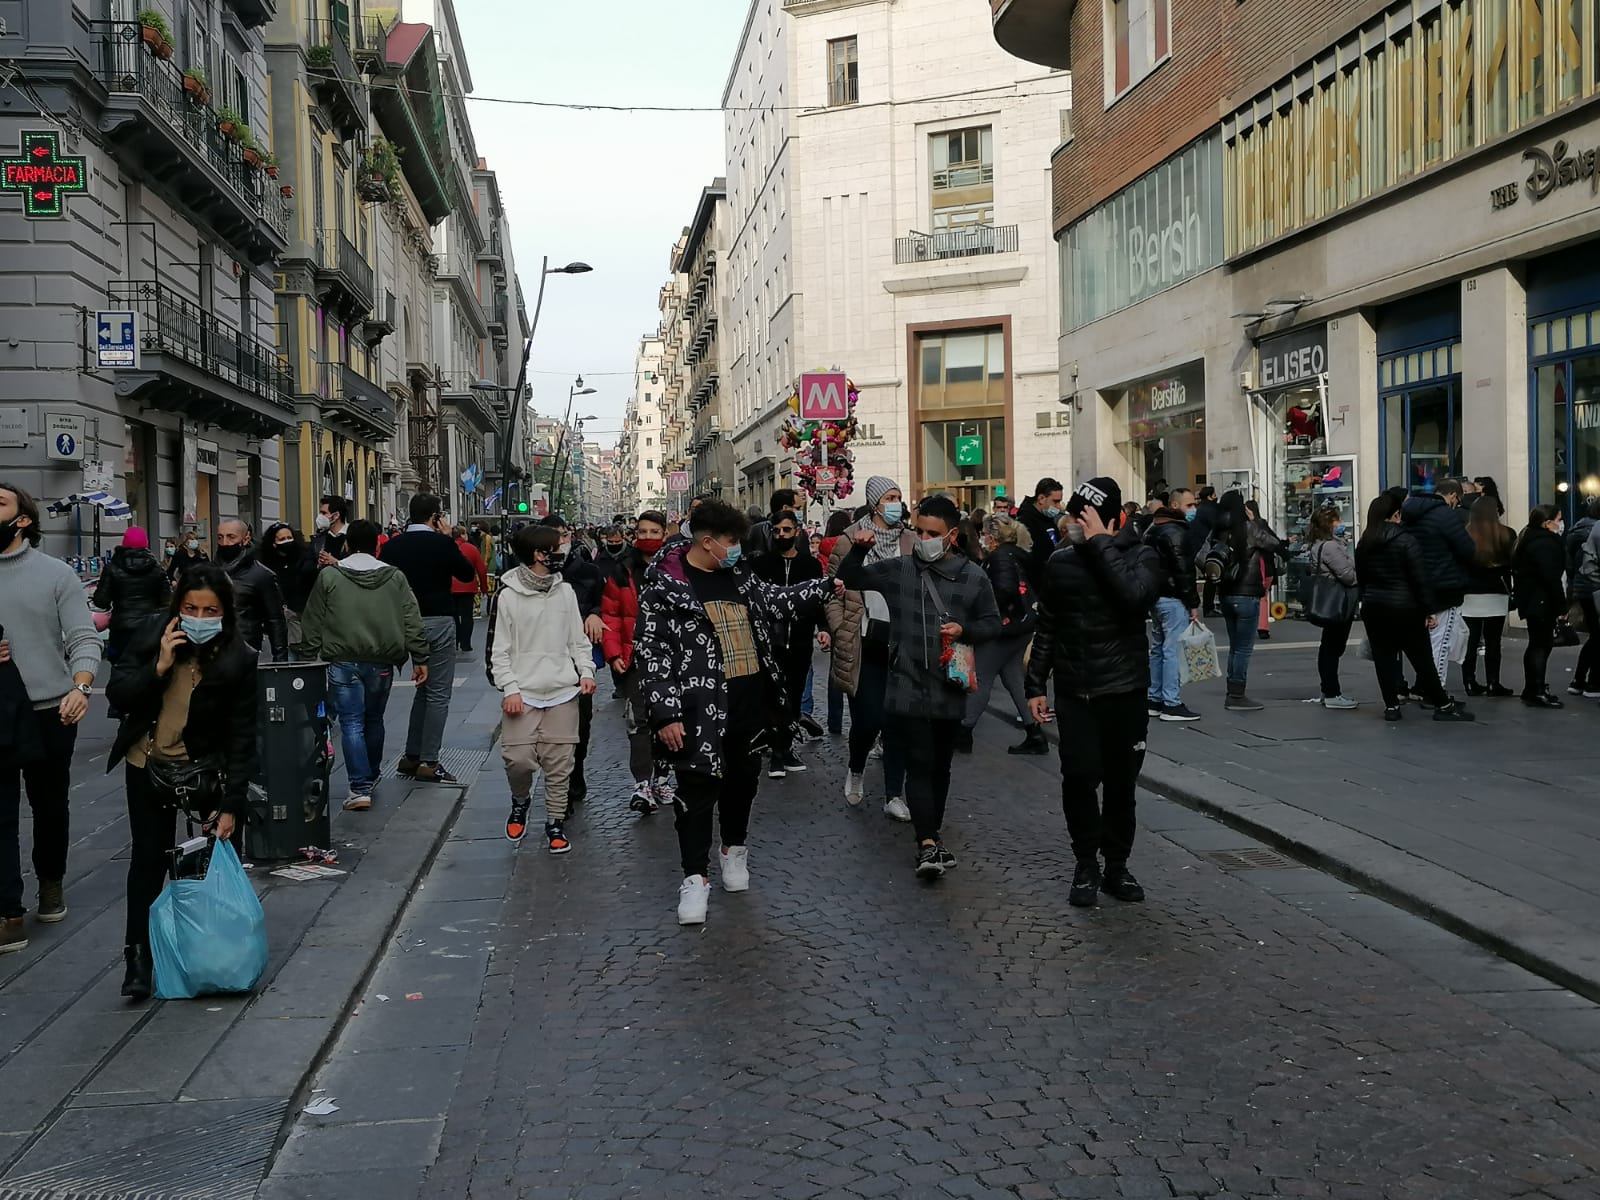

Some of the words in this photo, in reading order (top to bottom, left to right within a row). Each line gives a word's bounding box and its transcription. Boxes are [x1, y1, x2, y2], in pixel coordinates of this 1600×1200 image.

[7, 165, 77, 183] FARMACIA
[1490, 182, 1519, 209] THE
[1128, 196, 1200, 297] Bersh
[1262, 344, 1324, 387] ELISEO
[805, 382, 843, 410] M
[1151, 380, 1186, 411] Bershka
[672, 475, 687, 488] M
